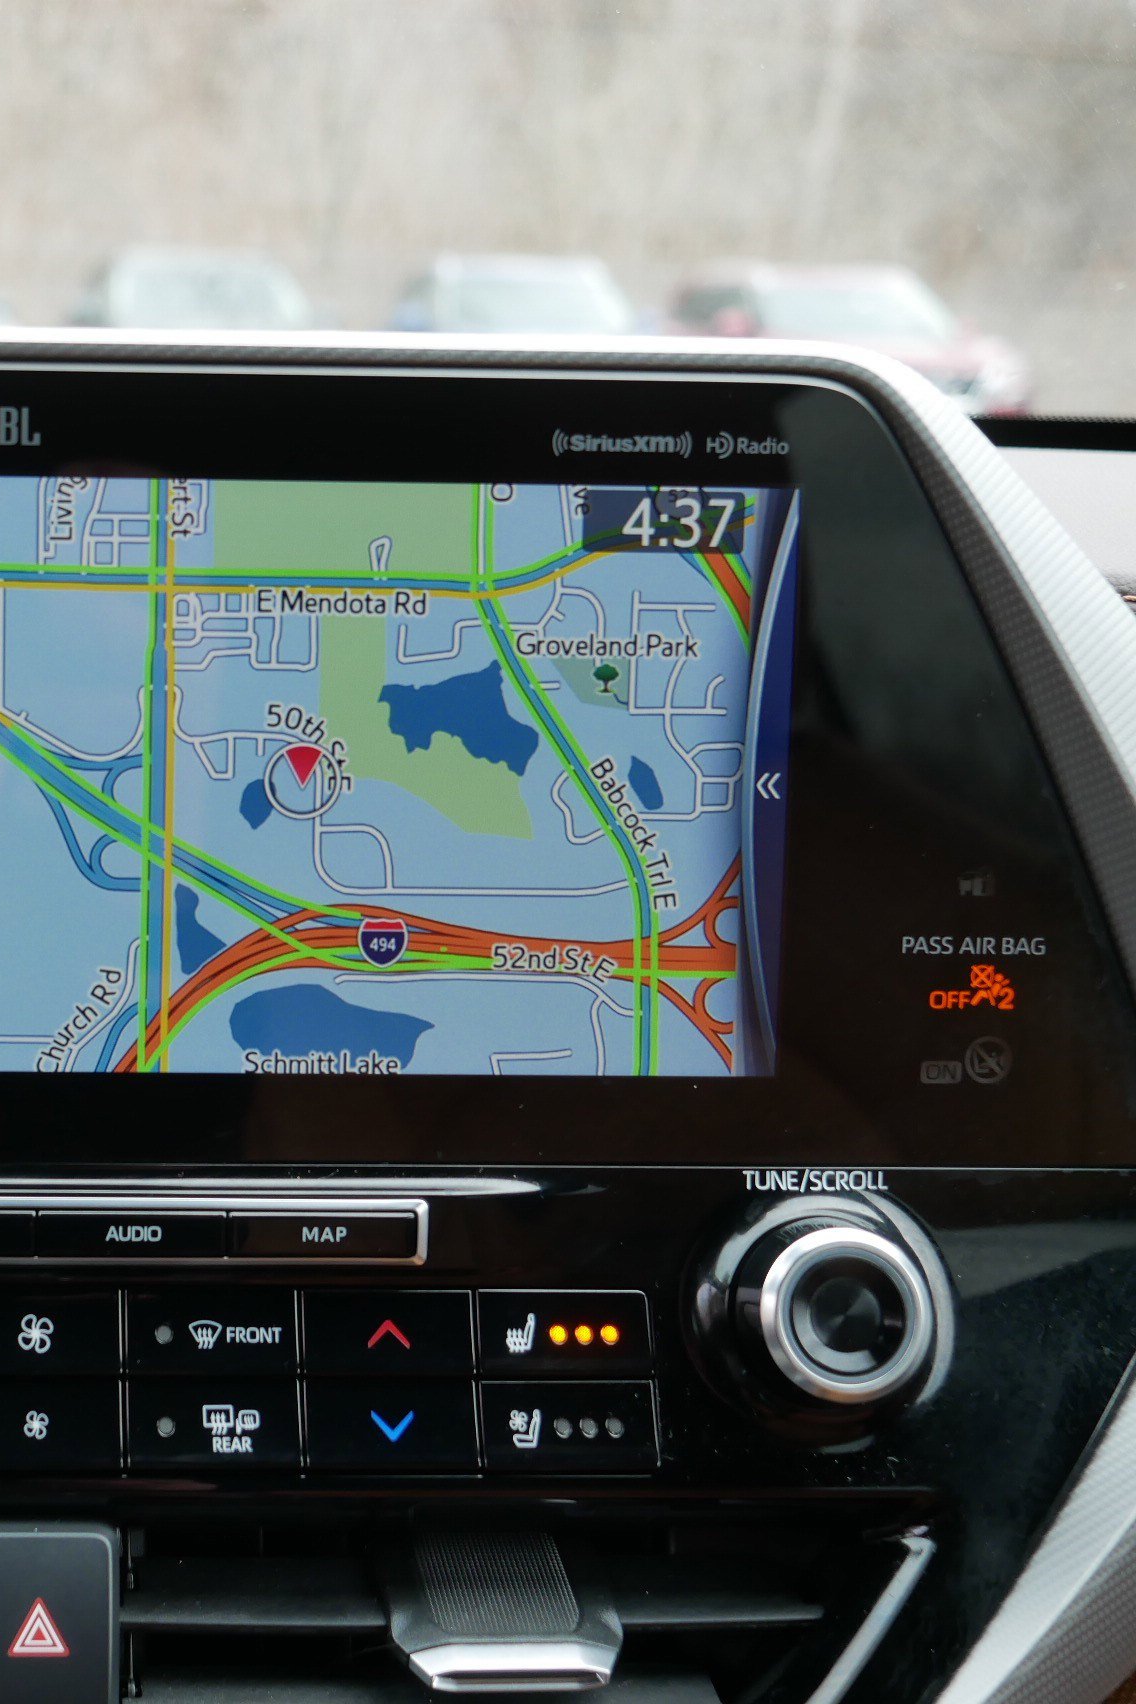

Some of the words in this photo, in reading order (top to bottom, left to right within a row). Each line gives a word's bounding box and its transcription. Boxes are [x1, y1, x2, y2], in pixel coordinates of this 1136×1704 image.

[736, 436, 790, 455] Radio
[621, 497, 737, 549] 4:37
[257, 592, 273, 613] E
[280, 591, 386, 616] Mendota
[394, 592, 426, 616] Rd
[515, 634, 638, 660] Groveland
[647, 635, 698, 658] Park
[266, 704, 325, 744] 50th
[590, 757, 657, 853] Babcock
[653, 892, 677, 910] E
[369, 937, 397, 953] 494
[901, 935, 954, 955] PASS
[959, 936, 996, 955] AIR
[1001, 936, 1047, 956] BAG
[492, 945, 557, 970] 52nd
[564, 948, 590, 973] St
[592, 957, 616, 983] E
[929, 990, 971, 1010] OFF
[36, 1005, 99, 1072] Church
[90, 968, 122, 1005] Rd
[245, 1050, 336, 1074] Schmitt
[341, 1052, 399, 1074] Lake
[742, 1168, 889, 1193] TUNE/SCROLL
[105, 1224, 163, 1243] AUDIO
[301, 1226, 348, 1244] MAP
[226, 1326, 283, 1345] FRONT
[212, 1436, 253, 1454] REAR
